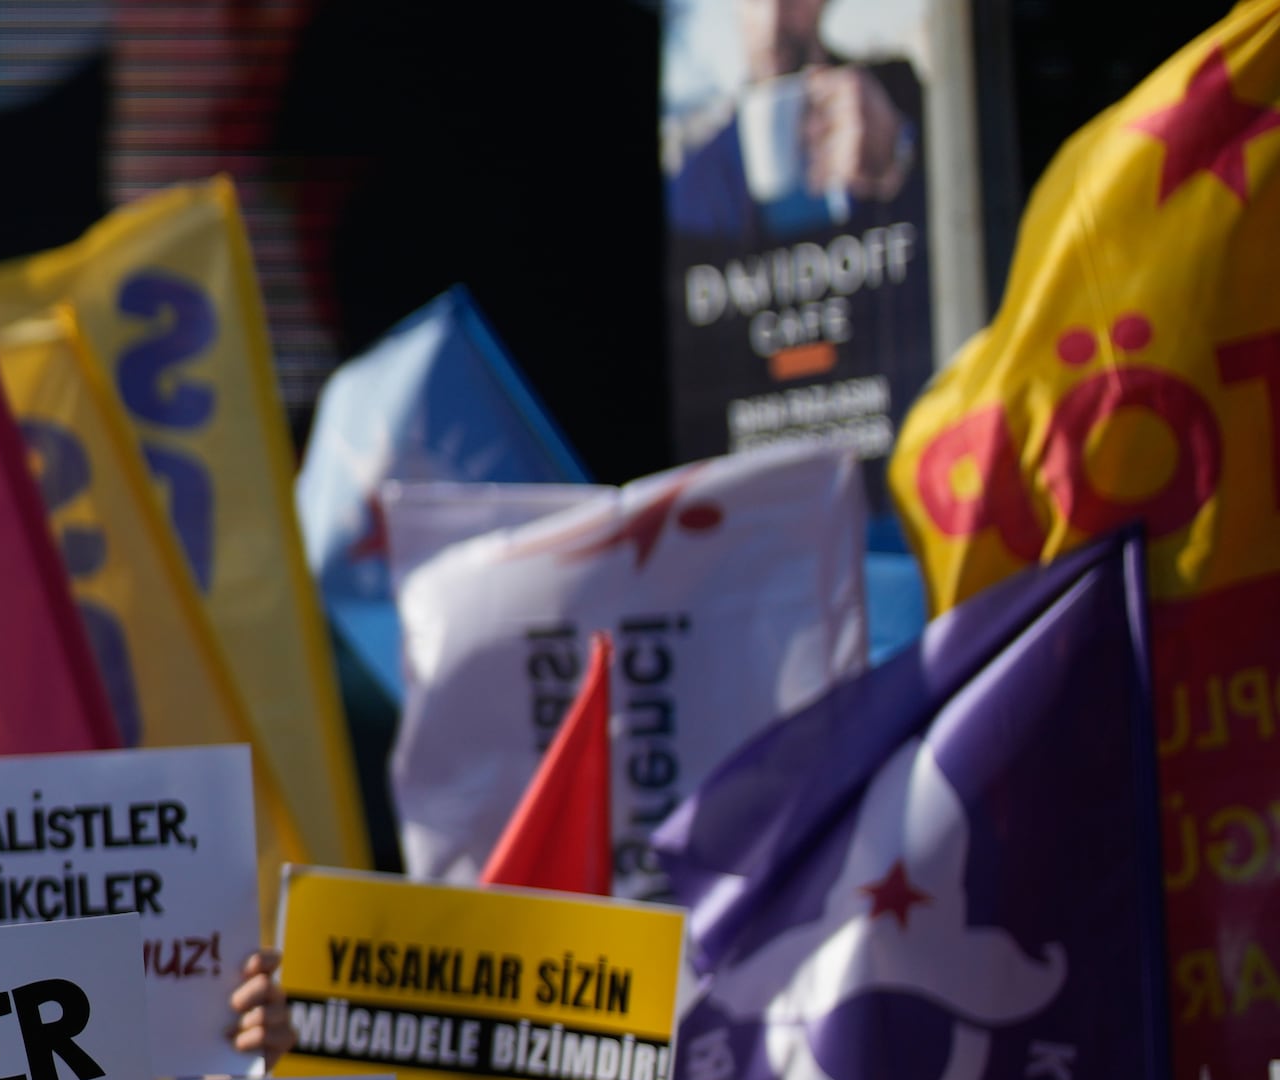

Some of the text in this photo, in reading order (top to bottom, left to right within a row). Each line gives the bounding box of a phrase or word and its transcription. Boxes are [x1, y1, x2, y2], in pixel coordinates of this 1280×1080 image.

[326, 935, 634, 1017] YASAKLAR SİZİN
[291, 998, 480, 1063] MÜCADELE
